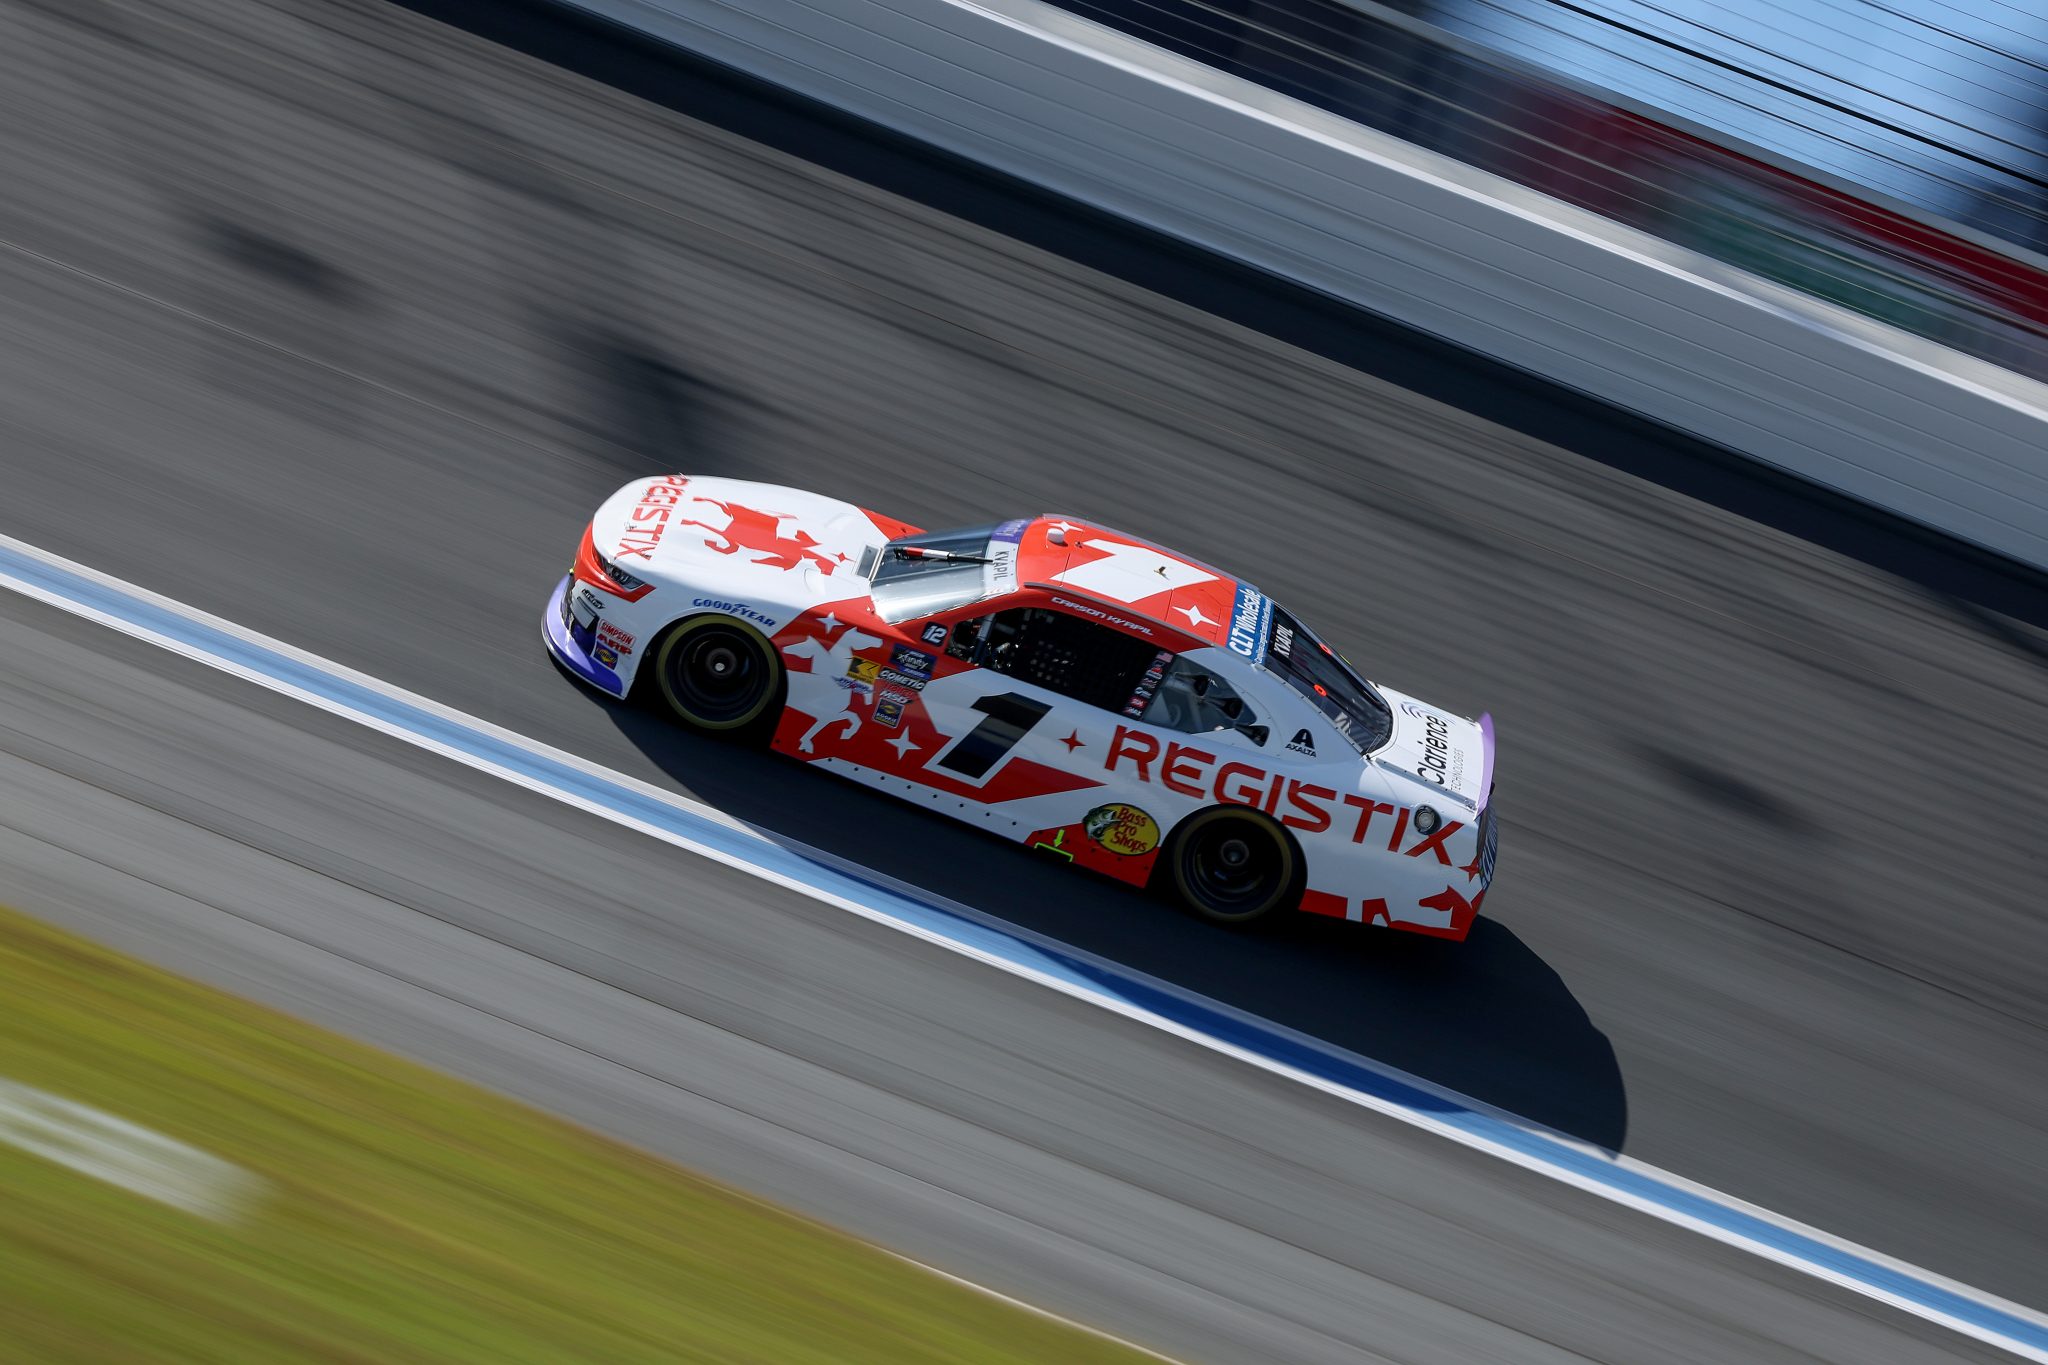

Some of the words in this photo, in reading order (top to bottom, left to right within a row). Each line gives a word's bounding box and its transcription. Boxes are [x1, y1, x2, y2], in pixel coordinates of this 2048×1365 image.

[993, 551, 1010, 581] KVAPIL
[693, 598, 776, 628] GOODYEAR
[1051, 596, 1107, 619] CARSON
[1106, 615, 1154, 636] KVAPIL
[1235, 588, 1262, 635] Wholesale
[601, 621, 634, 645] SIMPSON
[921, 625, 948, 644] 12
[1228, 627, 1255, 656] CLT
[1273, 623, 1294, 659] KVAPIL
[880, 669, 925, 690] COMETIC
[936, 691, 1054, 779] 1
[1285, 743, 1317, 758] AXALTA
[1417, 715, 1448, 785] Clarience
[1104, 724, 1464, 867] REGISTIX
[1115, 820, 1137, 837] Pro
[1117, 807, 1147, 827] Bass
[1111, 832, 1147, 852] Shops
